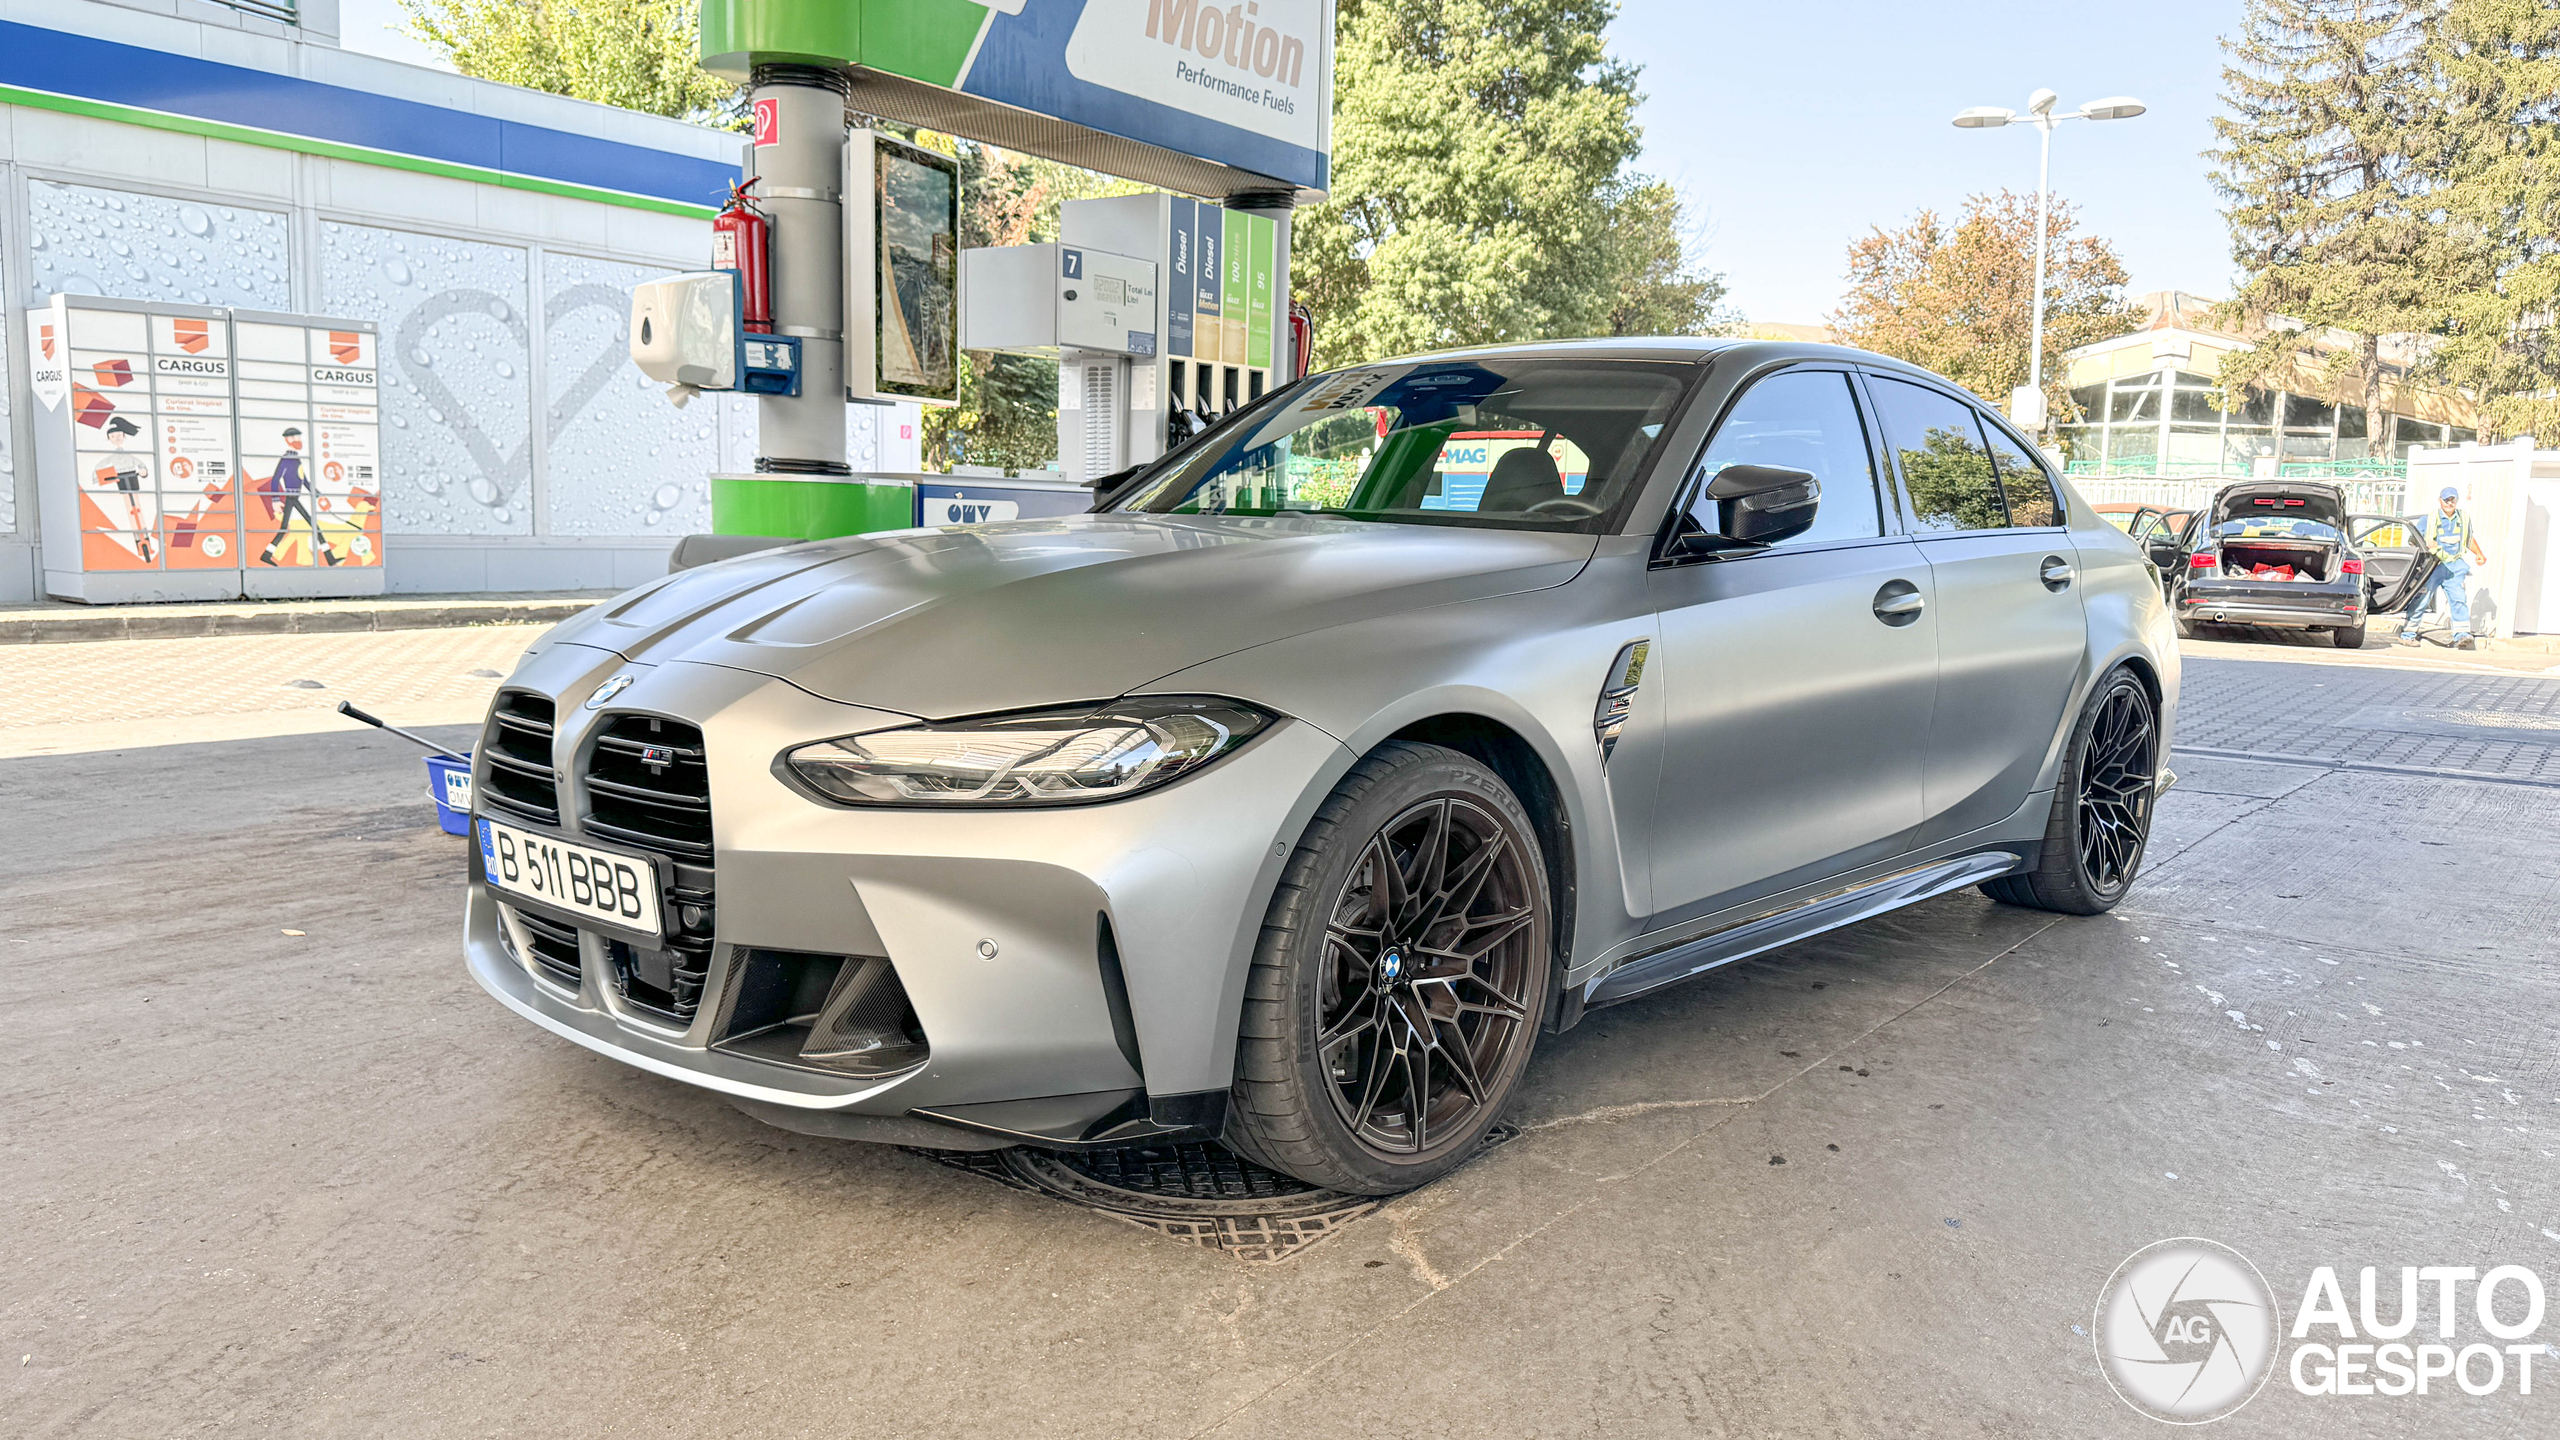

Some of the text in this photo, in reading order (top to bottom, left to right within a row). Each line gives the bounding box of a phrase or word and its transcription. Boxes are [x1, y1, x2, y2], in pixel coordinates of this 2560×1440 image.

[1145, 0, 1304, 88] Motion
[1176, 60, 1295, 115] Performance Fuels
[1177, 229, 1188, 275] Diesel
[1205, 235, 1215, 280] Diesel
[1067, 254, 1078, 274] 7
[1127, 284, 1143, 295] Total
[1256, 271, 1265, 290] 95
[1127, 295, 1139, 304] Litri
[36, 369, 63, 382] CARGUS
[157, 359, 226, 374] CARGUS
[314, 370, 374, 384] CARGUS
[947, 504, 991, 523] OMV
[447, 773, 471, 788] OMV
[485, 854, 498, 877] RO
[498, 830, 642, 920] B 511 BBB
